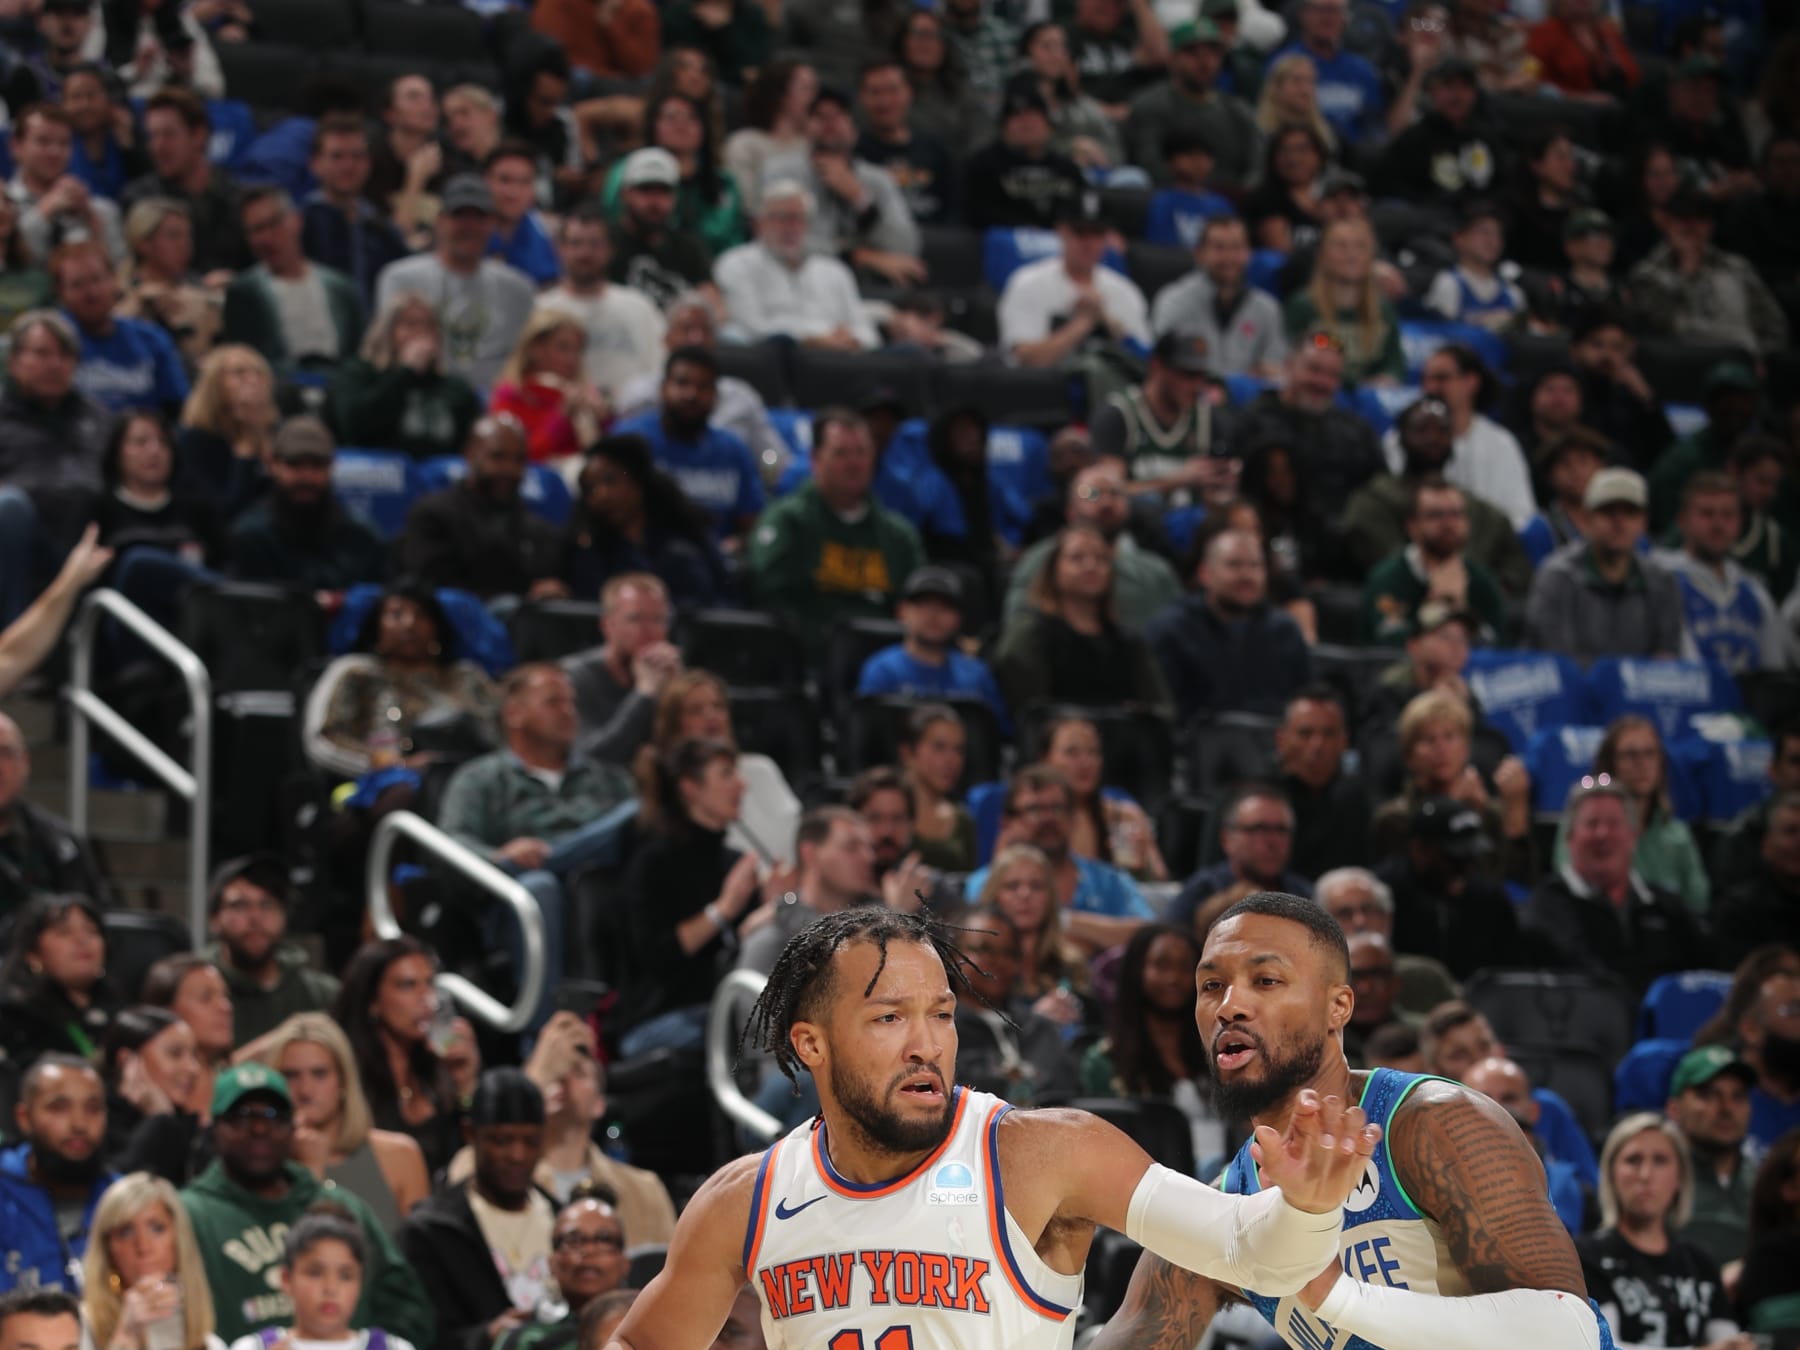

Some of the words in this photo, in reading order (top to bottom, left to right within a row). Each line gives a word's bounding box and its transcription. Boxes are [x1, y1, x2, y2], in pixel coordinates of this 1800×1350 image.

[930, 1191, 978, 1205] sphere
[757, 1251, 857, 1321] NEW
[859, 1249, 992, 1317] YORK
